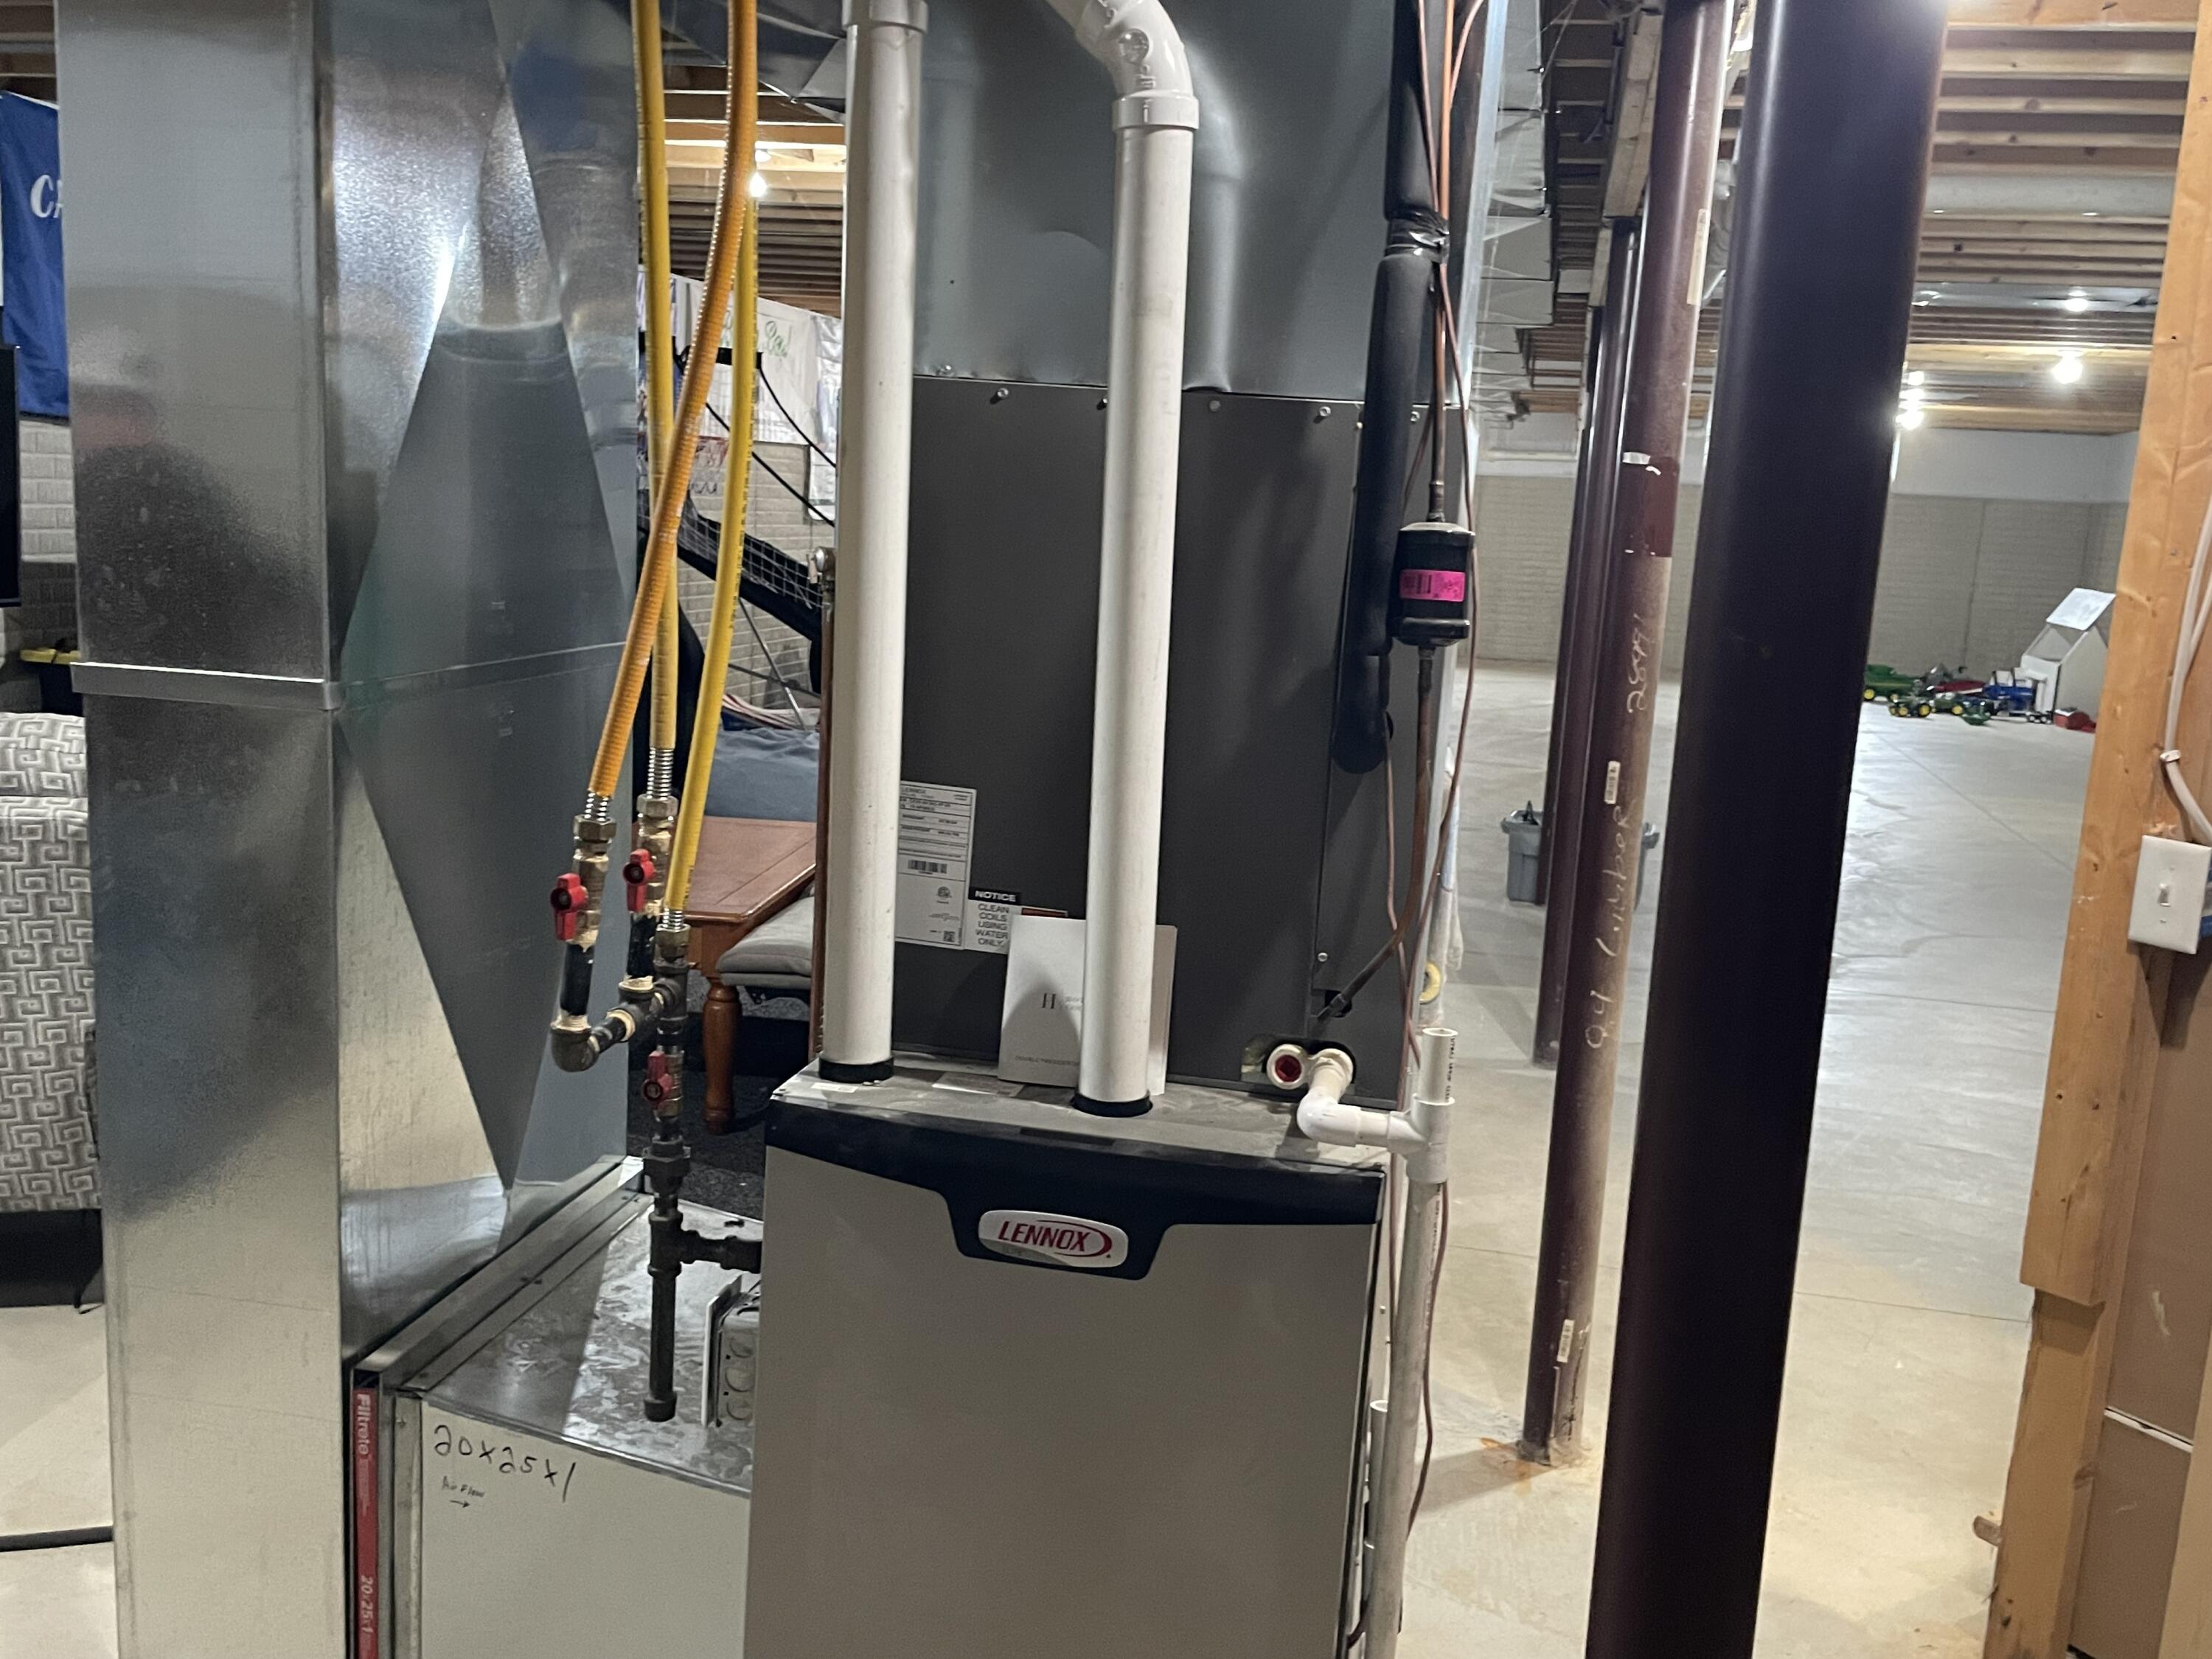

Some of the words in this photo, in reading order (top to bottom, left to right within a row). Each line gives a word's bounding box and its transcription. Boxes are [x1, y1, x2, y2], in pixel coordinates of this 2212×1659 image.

[974, 890, 1016, 902] NOTICE
[978, 902, 1010, 914] CLEAN
[978, 911, 1008, 922] COILS
[978, 920, 1008, 931] USING
[975, 928, 1009, 939] WATER
[998, 1220, 1091, 1252] LENNOX
